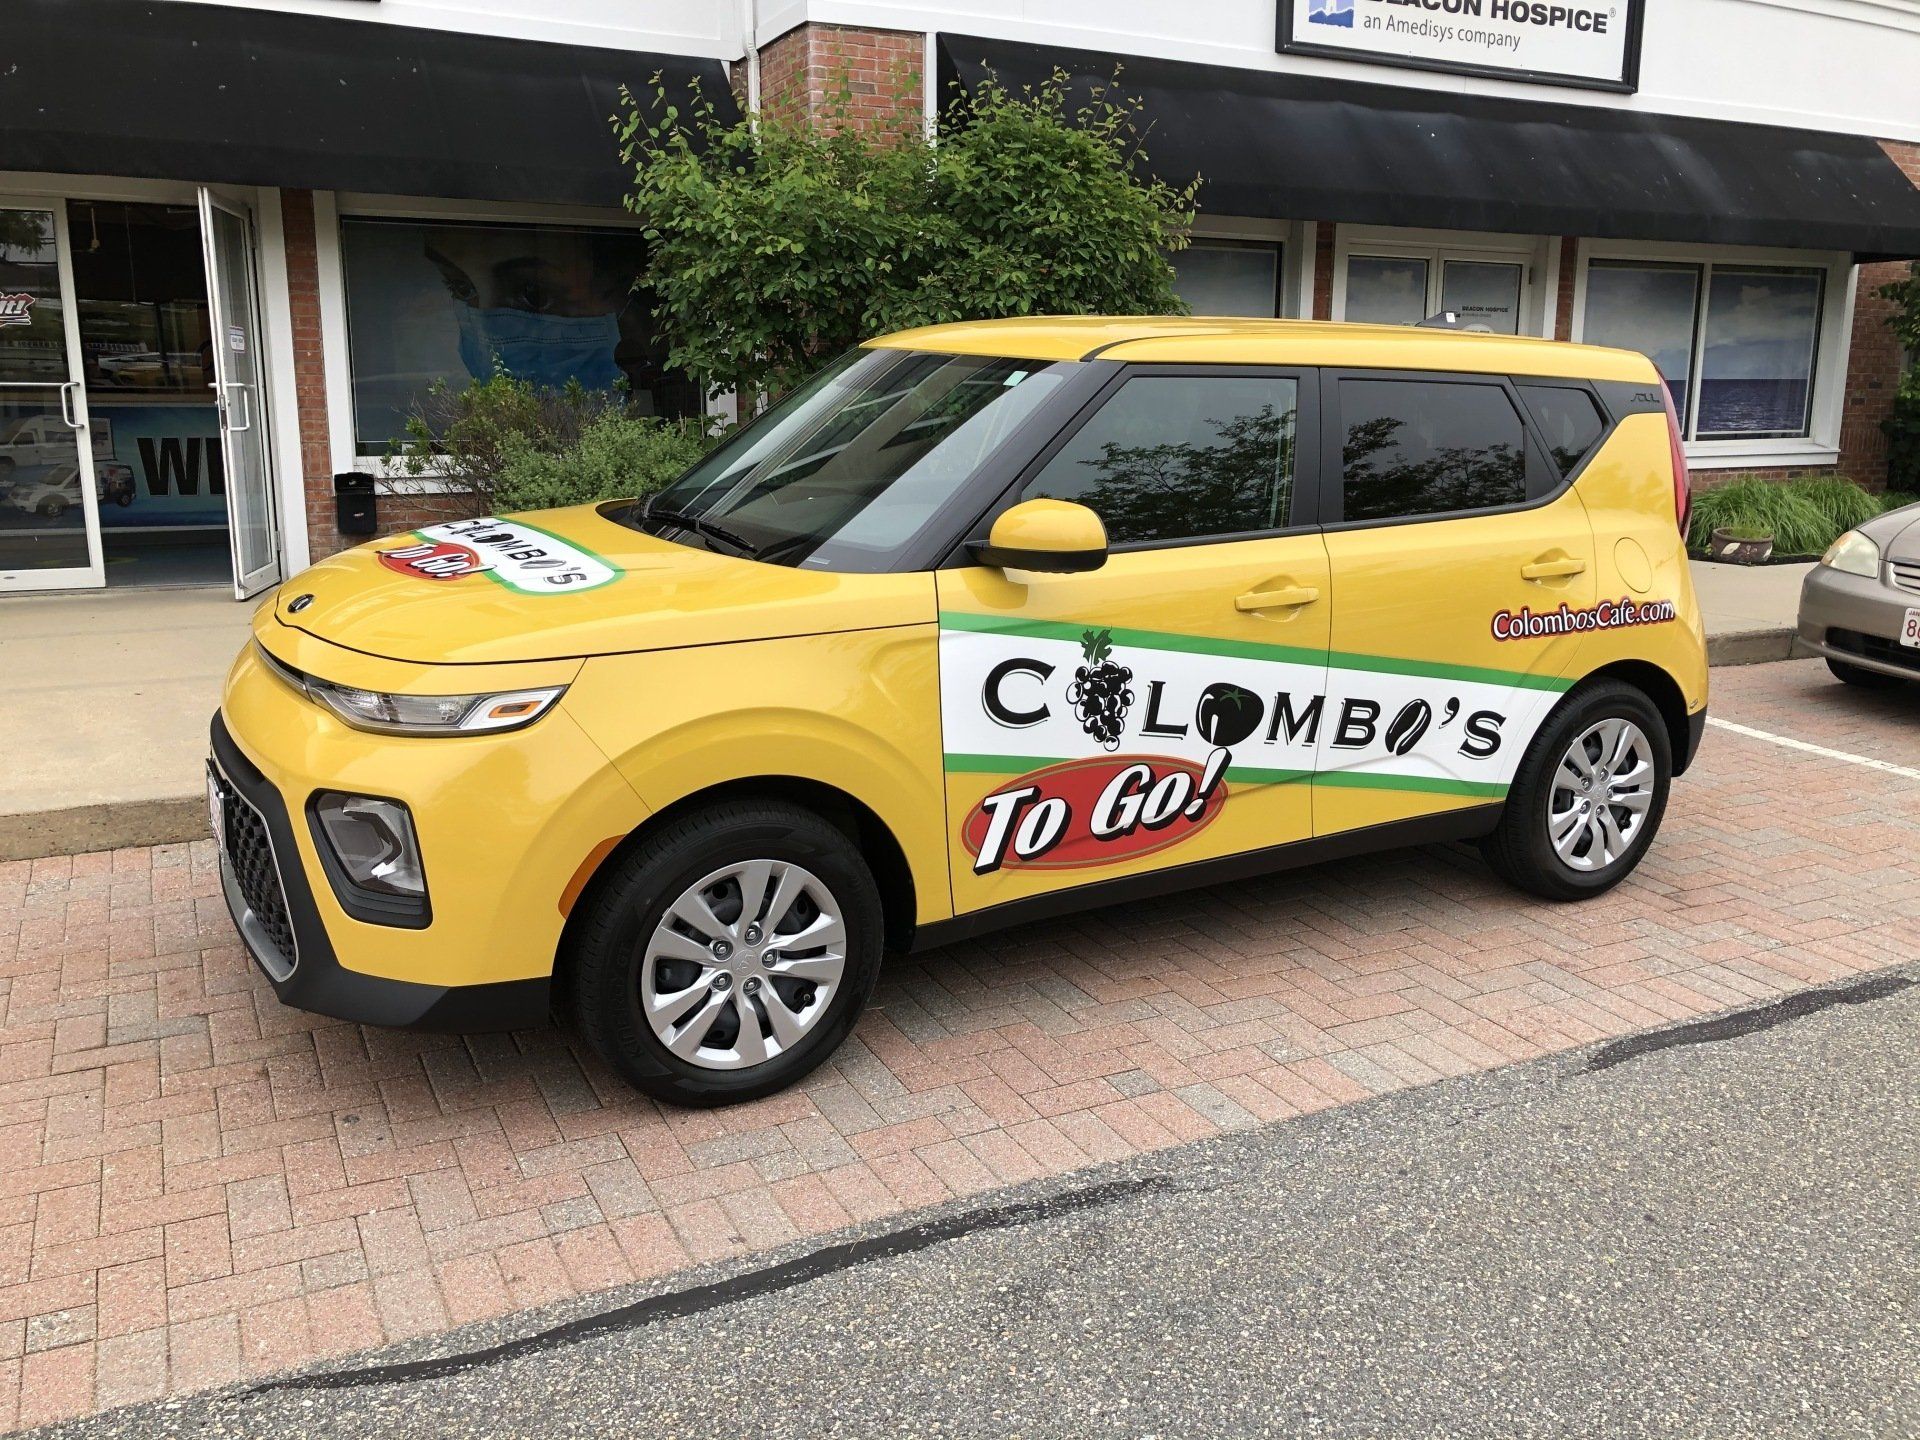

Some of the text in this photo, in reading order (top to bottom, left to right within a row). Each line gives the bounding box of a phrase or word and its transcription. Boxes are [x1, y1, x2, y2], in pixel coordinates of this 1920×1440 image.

[1363, 14, 1522, 51] an Amedisys company
[1492, 599, 1676, 640] ColombosCafe.com
